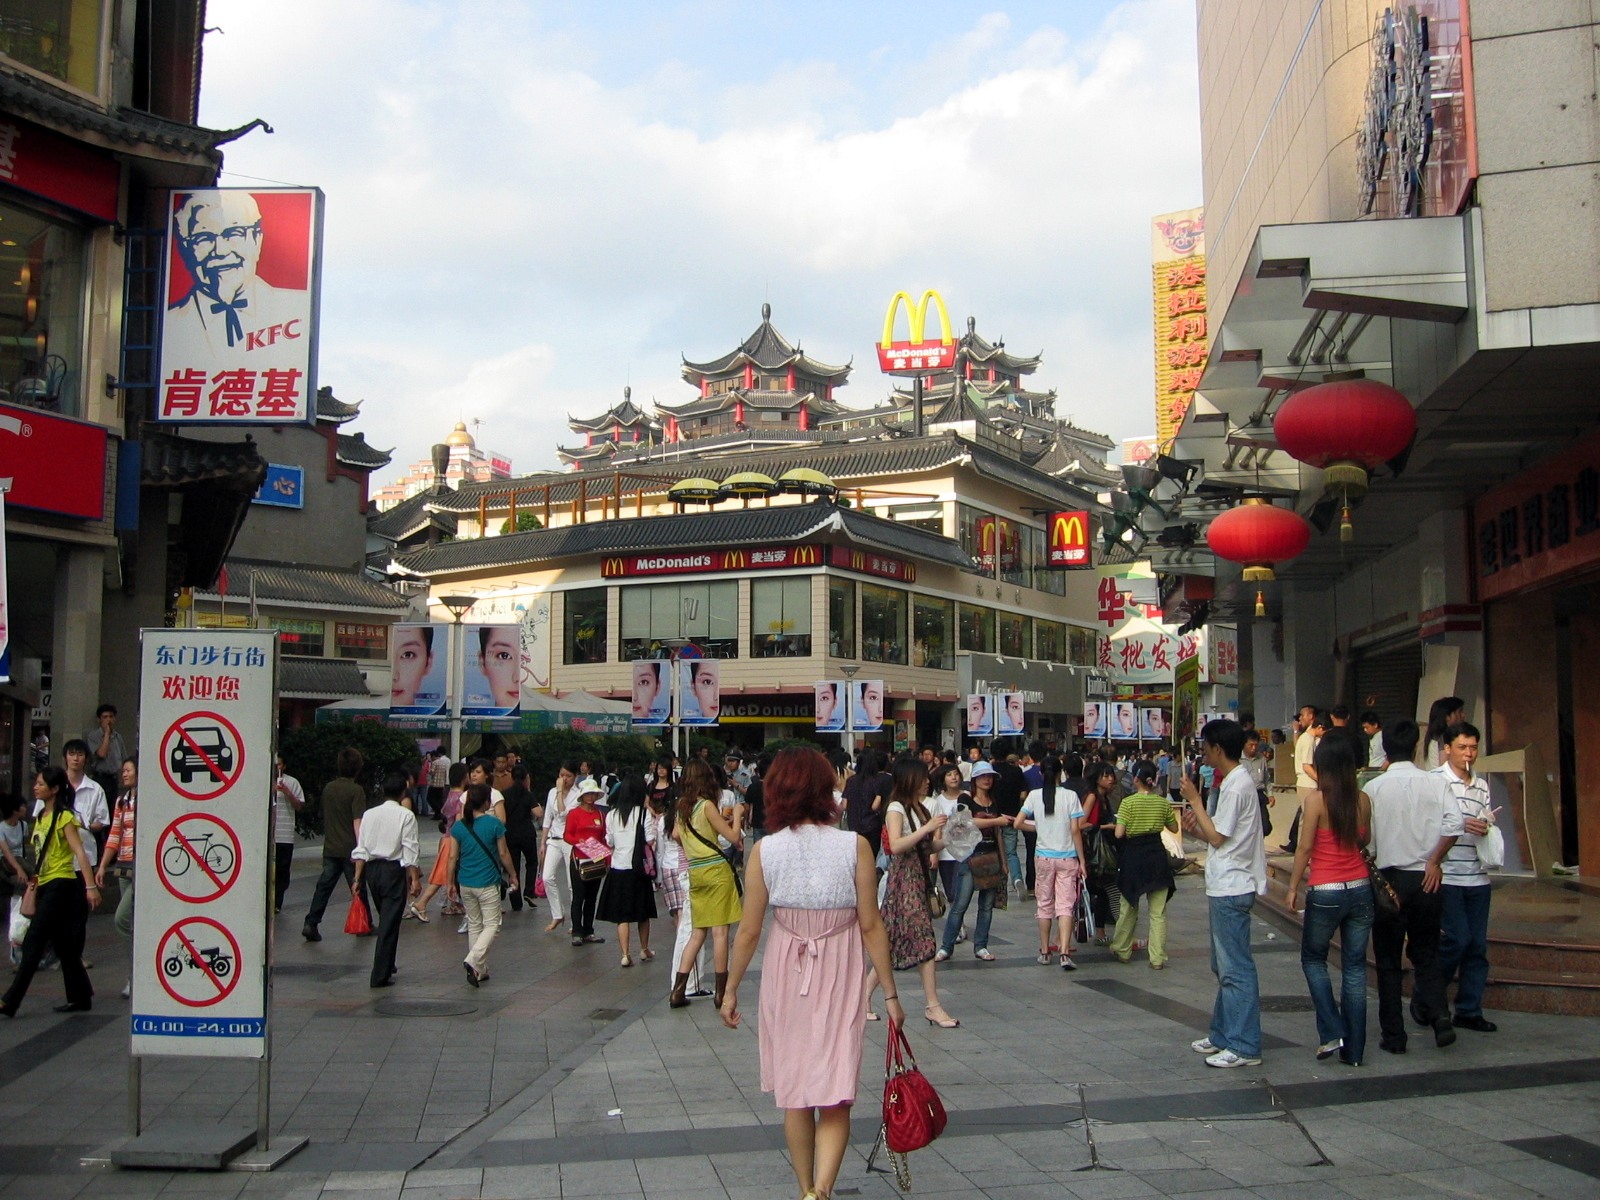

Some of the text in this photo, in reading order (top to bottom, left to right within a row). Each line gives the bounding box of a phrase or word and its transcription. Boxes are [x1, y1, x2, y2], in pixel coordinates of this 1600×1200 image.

[246, 319, 302, 351] KFC
[886, 347, 947, 358] McDonald's
[893, 356, 940, 369] 麦当劳
[163, 368, 302, 416] 肯德基
[636, 555, 711, 570] McDonald's
[751, 550, 787, 564] 麦当劳
[1051, 549, 1085, 561] 麦当劳
[872, 558, 897, 574] 麦当劳
[155, 645, 266, 667] 东门步行街
[162, 675, 240, 700] 欢迎您
[720, 704, 816, 719] McDonald'
